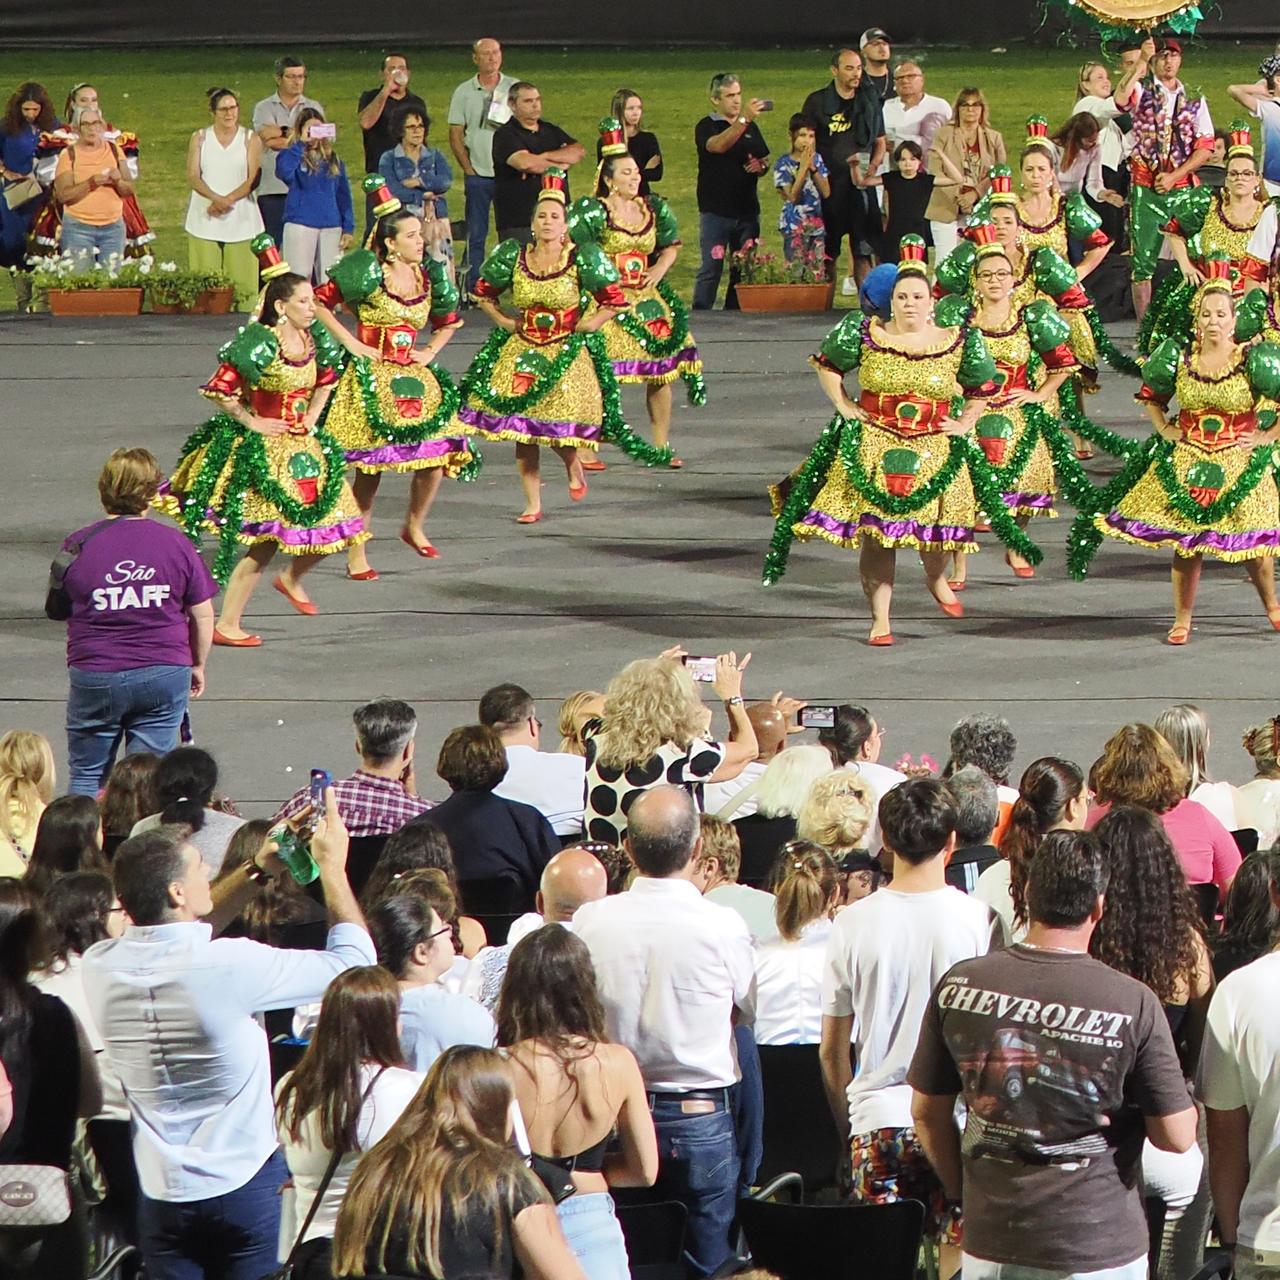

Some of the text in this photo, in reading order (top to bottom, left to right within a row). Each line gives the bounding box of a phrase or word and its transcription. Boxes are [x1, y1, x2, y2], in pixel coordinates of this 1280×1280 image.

[105, 560, 157, 585] São
[92, 584, 171, 611] STAFF
[937, 984, 1132, 1038] CHEVROLET
[1040, 1028, 1105, 1047] APACHE
